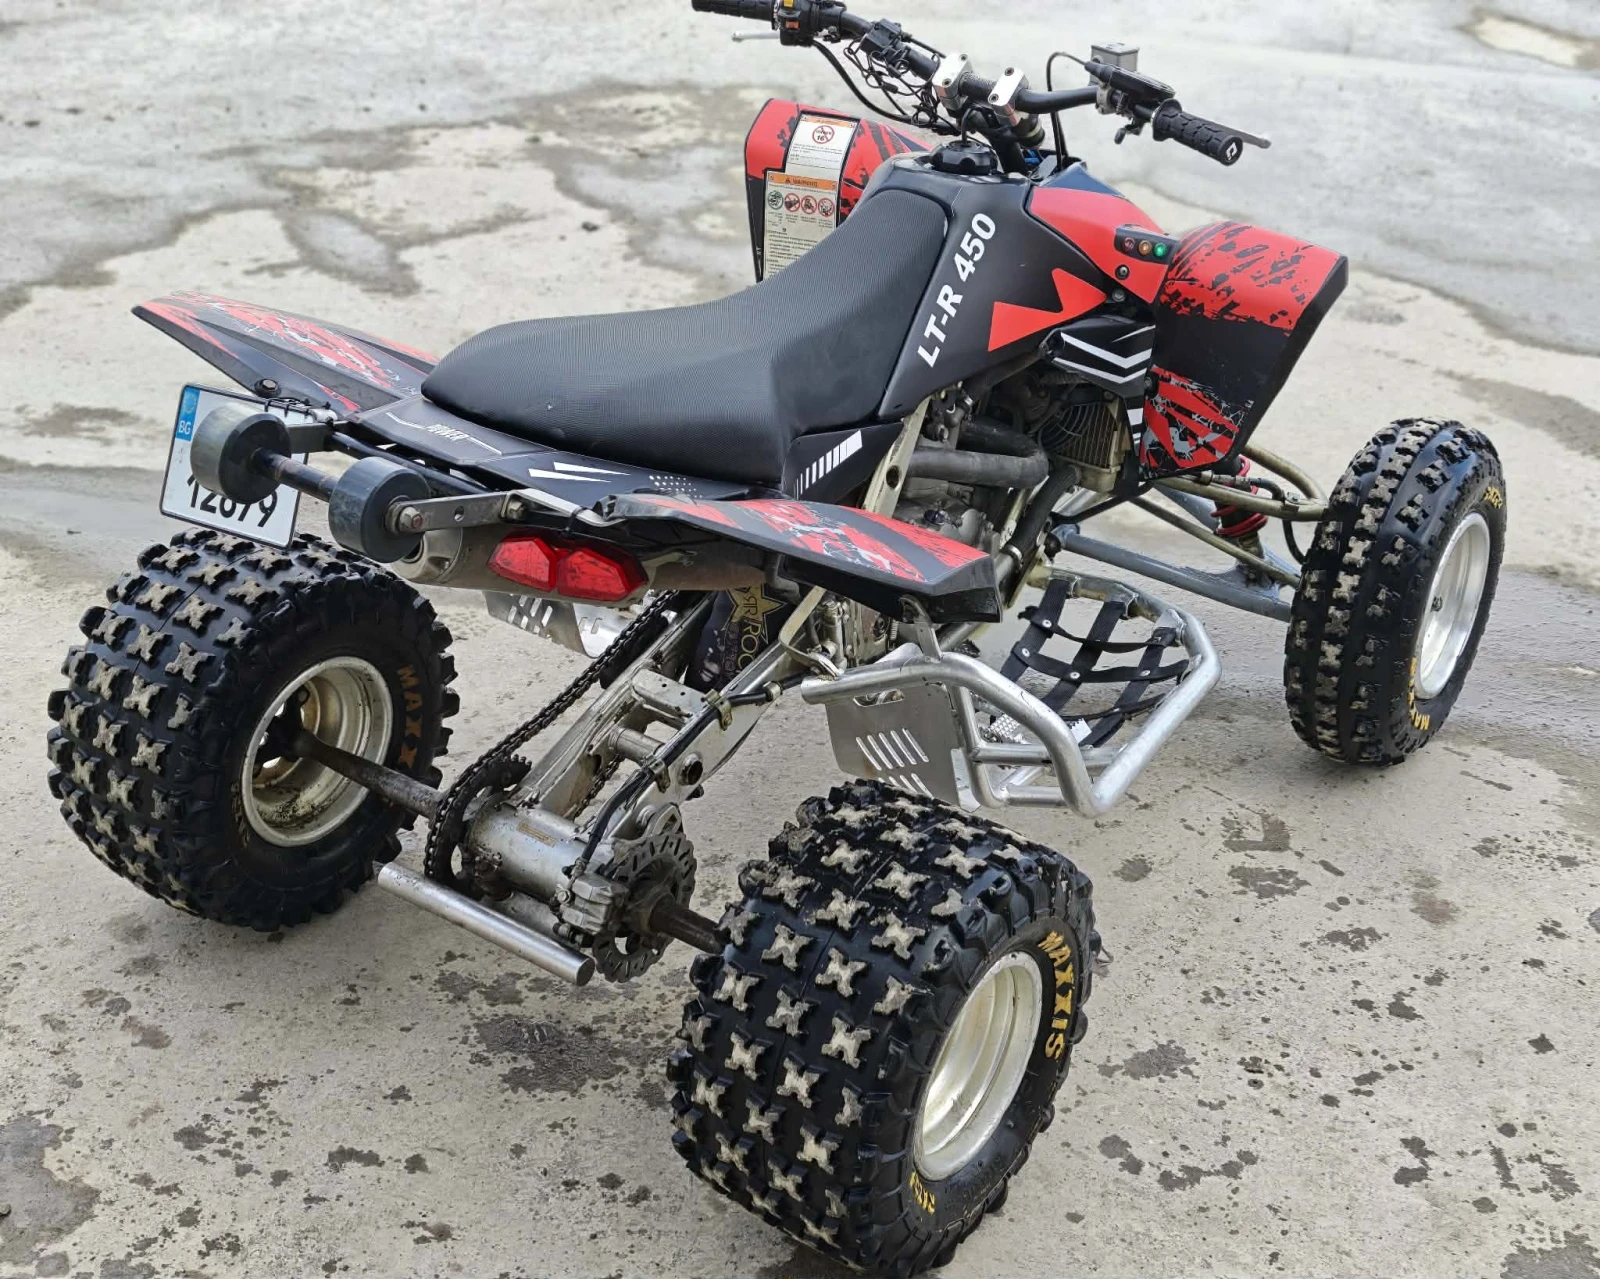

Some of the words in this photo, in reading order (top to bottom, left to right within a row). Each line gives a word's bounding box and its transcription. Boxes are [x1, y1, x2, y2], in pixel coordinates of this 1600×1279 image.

[917, 284, 963, 368] LT-R
[953, 212, 996, 282] 450
[179, 420, 192, 435] BG
[738, 620, 762, 674] ROC
[397, 664, 424, 769] MAXX
[1037, 930, 1075, 1060] MAXXIS
